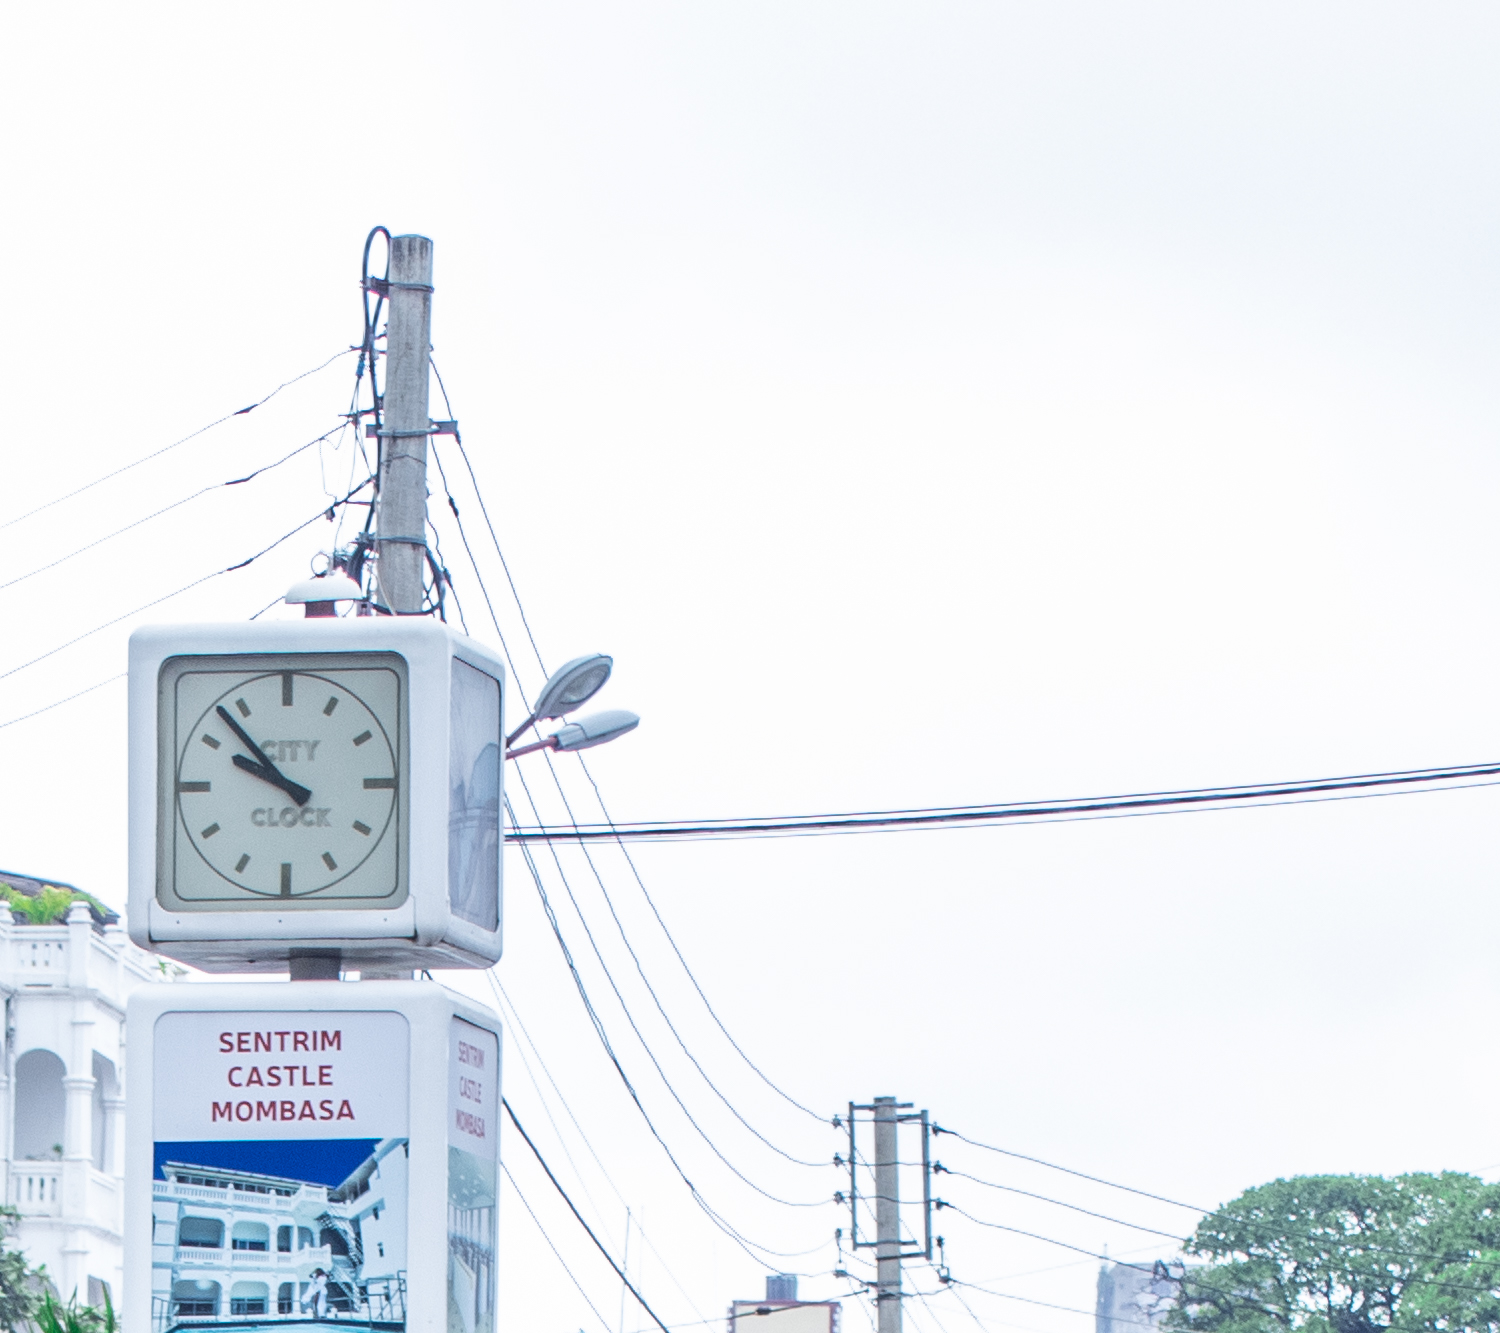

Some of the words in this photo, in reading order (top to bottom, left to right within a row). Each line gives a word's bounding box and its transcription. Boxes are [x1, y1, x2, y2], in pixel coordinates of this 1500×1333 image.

[261, 740, 321, 762] CITY
[251, 807, 332, 828] CLOCK
[219, 1030, 342, 1053] SENTRIM
[228, 1065, 333, 1088] CASTLE
[212, 1100, 355, 1122] MOMBASA
